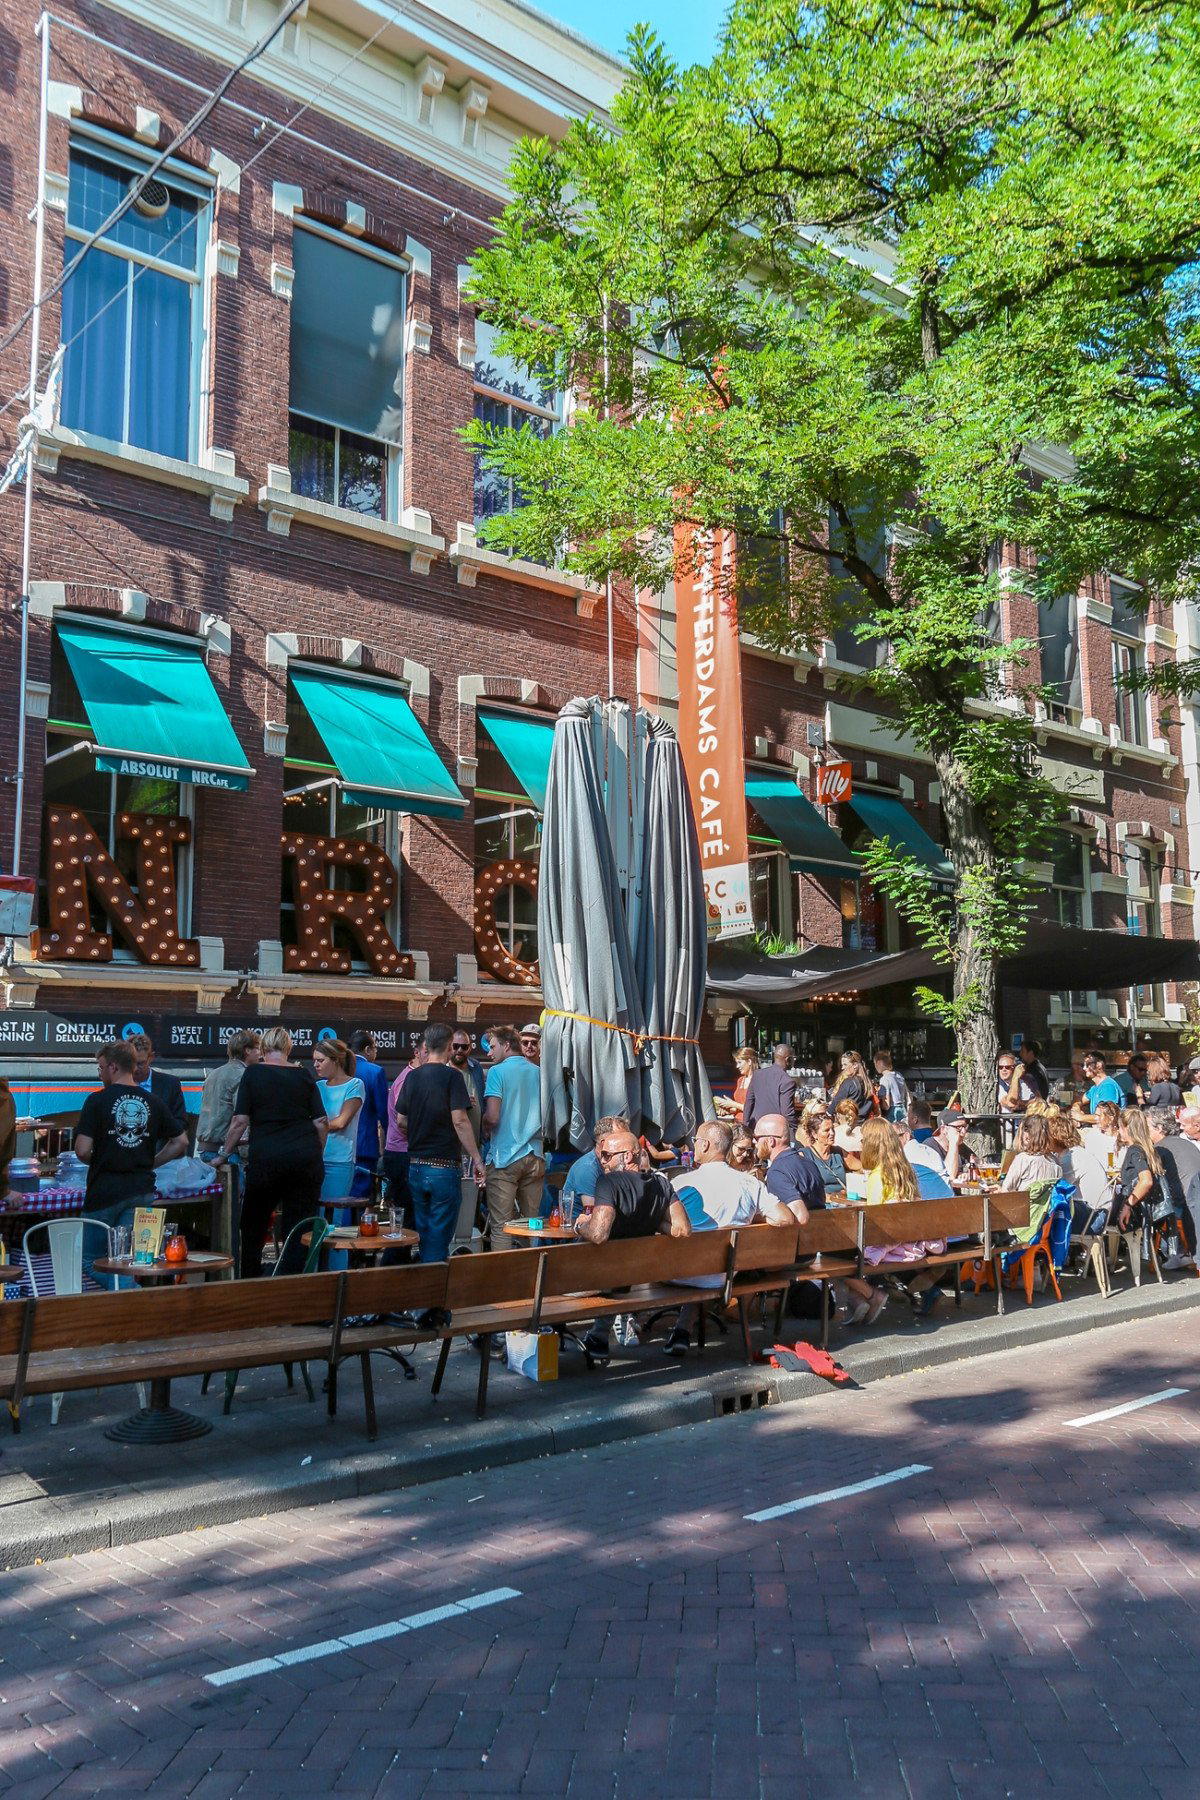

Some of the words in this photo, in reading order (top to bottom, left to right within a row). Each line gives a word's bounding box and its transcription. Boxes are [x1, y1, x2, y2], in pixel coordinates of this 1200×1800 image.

[120, 760, 179, 780] ABSOLUT
[821, 770, 850, 802] illy
[700, 768, 729, 858] CAFÉ
[0, 1022, 18, 1031] ST
[23, 1022, 35, 1031] IN
[56, 1023, 116, 1035] ONTBIJT
[171, 1026, 203, 1035] SWEET
[93, 1035, 116, 1043] 14,50
[289, 1028, 312, 1039] MET
[171, 1034, 203, 1045] DEAL
